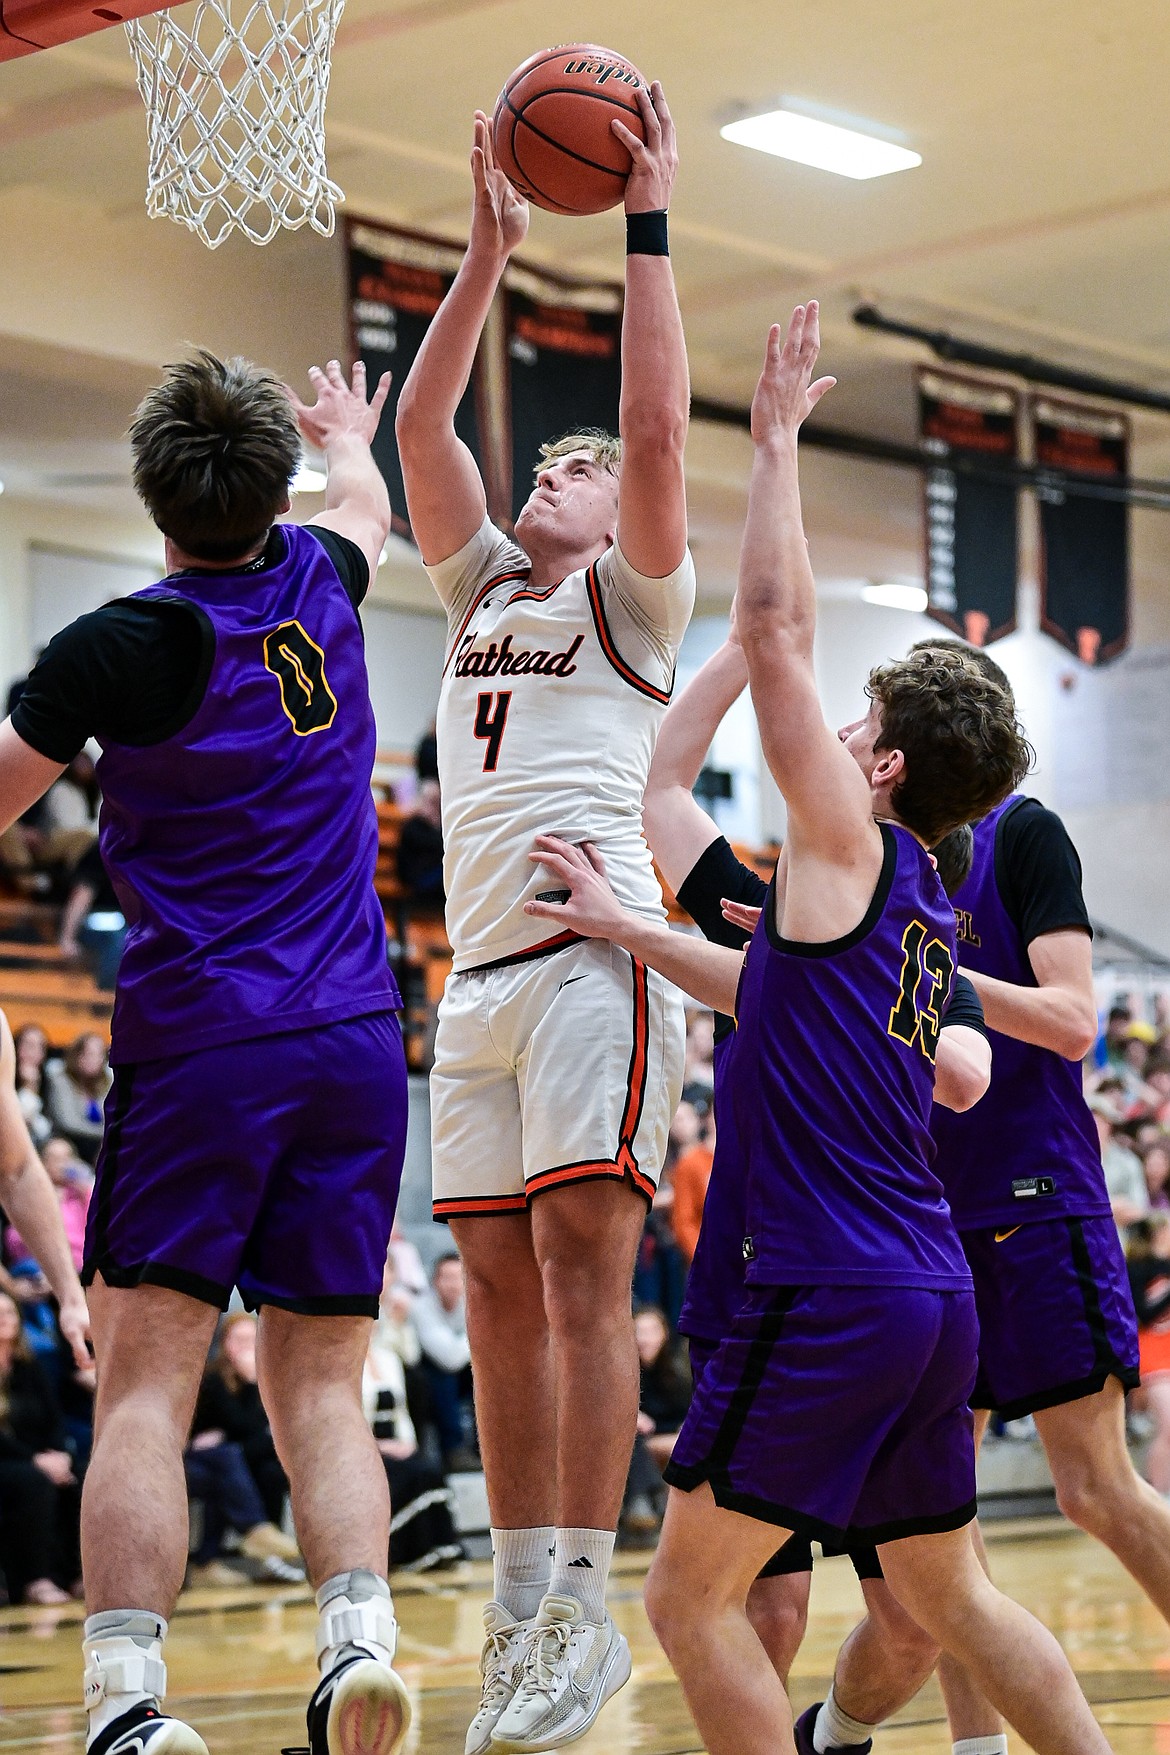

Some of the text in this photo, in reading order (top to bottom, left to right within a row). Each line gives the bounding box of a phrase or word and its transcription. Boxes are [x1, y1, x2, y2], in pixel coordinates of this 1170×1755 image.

[563, 60, 641, 88] aden
[263, 619, 337, 736] 0
[473, 690, 513, 772] 4
[887, 919, 955, 1065] 13
